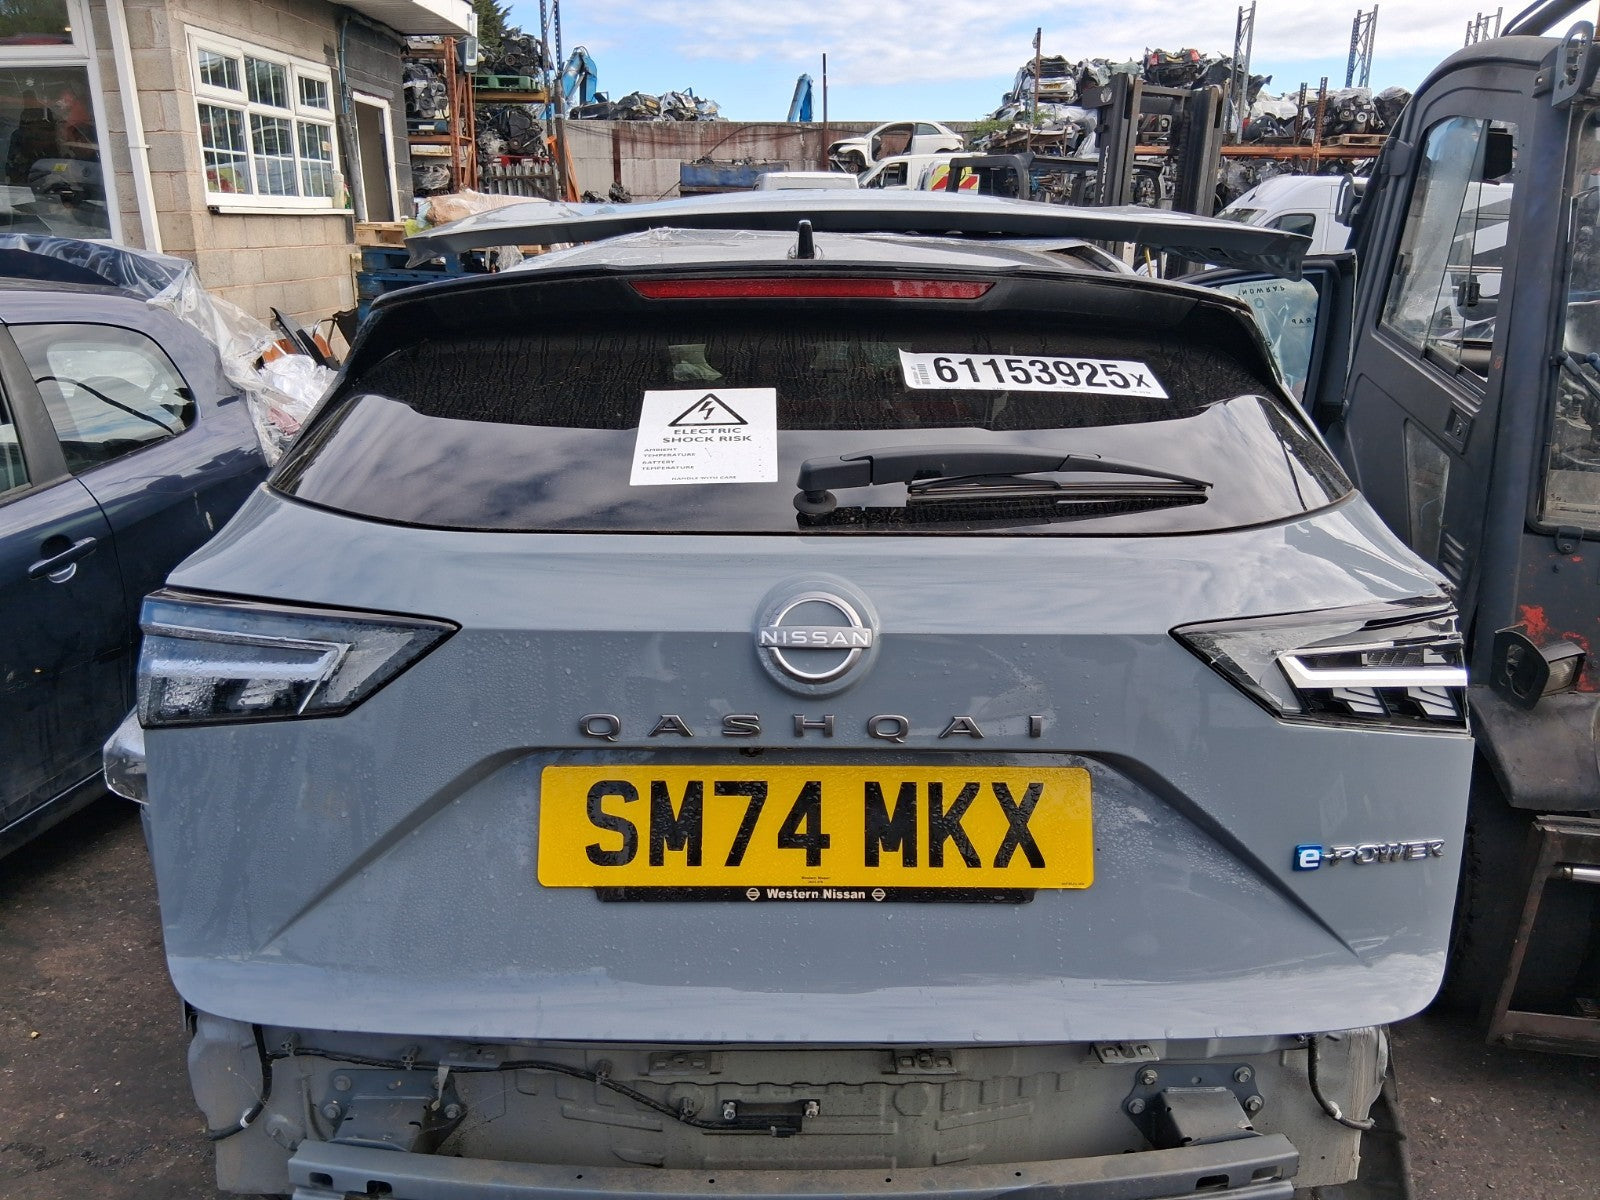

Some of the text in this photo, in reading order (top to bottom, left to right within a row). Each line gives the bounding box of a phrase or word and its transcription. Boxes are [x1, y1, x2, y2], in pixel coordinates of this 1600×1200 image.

[673, 427, 742, 435] ELECTRIC
[662, 436, 714, 444] SHOCK
[760, 630, 870, 646] NISSAN
[579, 714, 1044, 743] QASHQAI
[585, 780, 1046, 868] SM74 MKX
[766, 888, 866, 899] Western Nissan
